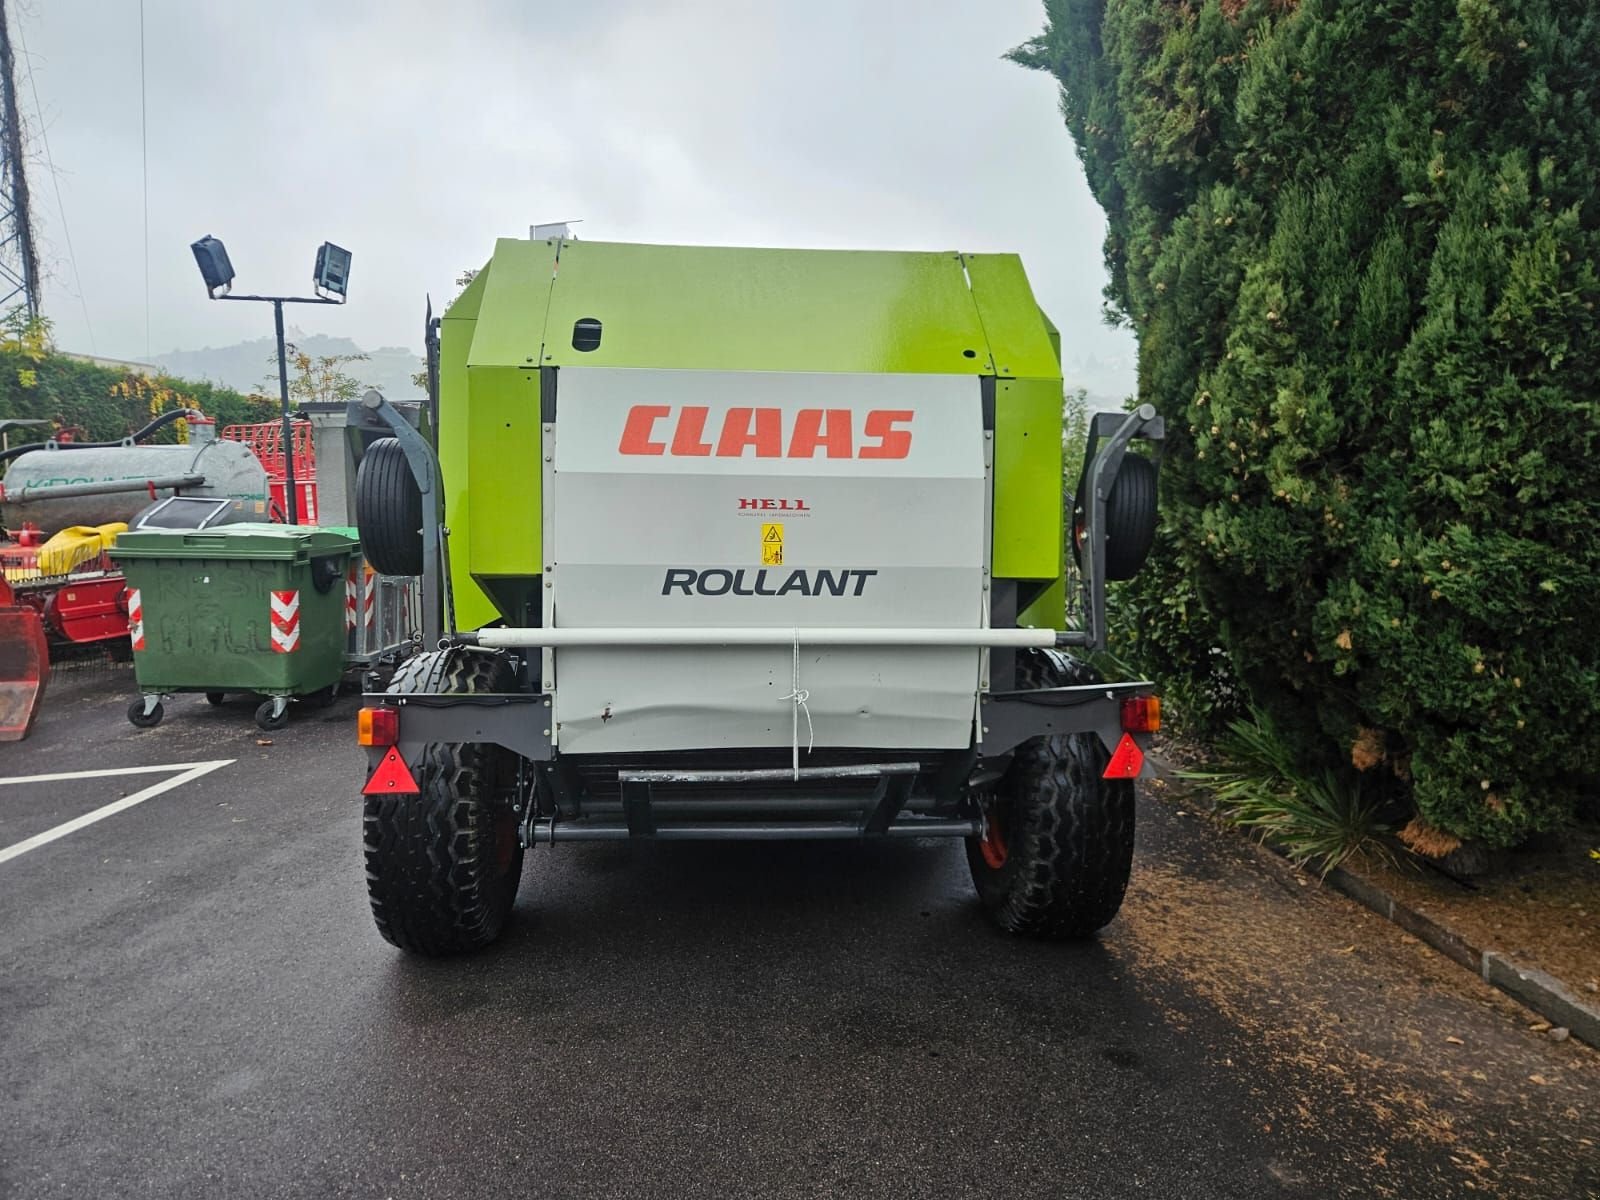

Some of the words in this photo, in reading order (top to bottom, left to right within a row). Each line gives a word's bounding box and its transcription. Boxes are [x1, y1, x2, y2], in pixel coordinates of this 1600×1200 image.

[618, 405, 914, 459] CLAAS
[737, 498, 811, 511] HELL
[661, 568, 878, 597] ROLLANT
